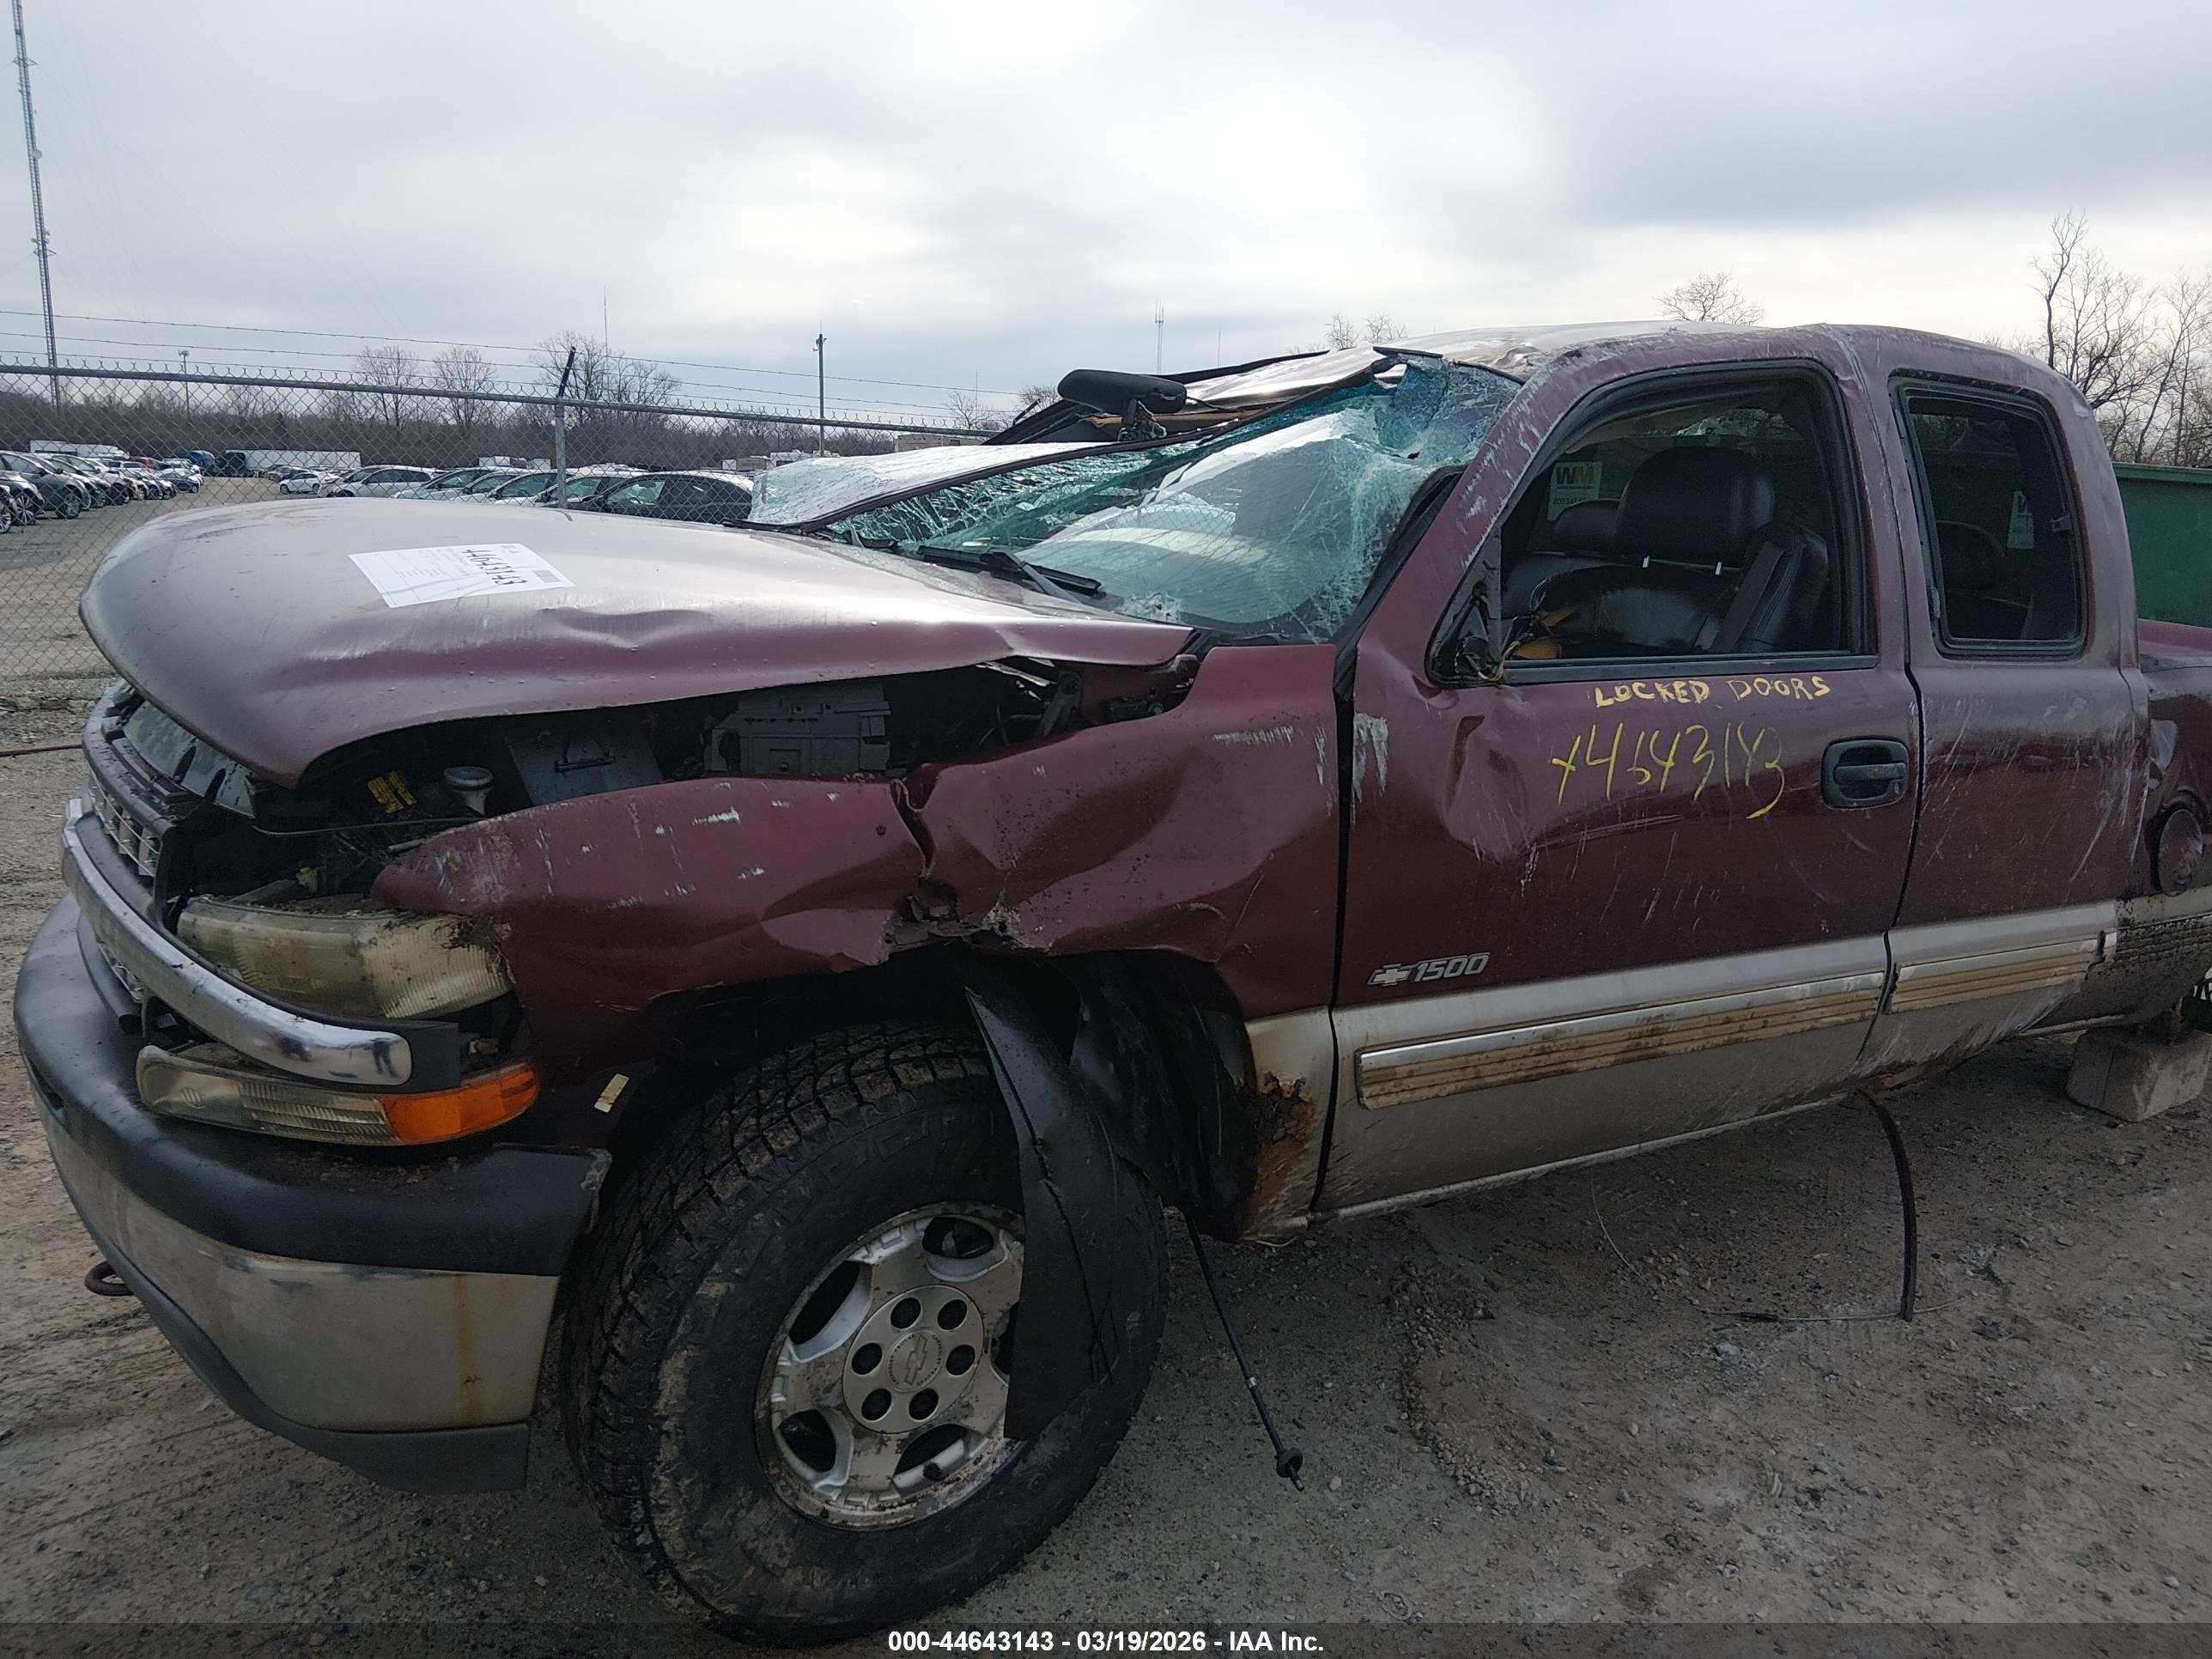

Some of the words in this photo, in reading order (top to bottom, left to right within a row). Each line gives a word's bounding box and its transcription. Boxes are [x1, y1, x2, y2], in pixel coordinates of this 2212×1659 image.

[461, 549, 528, 586] 44643143
[1595, 681, 1711, 708] LOCKED
[1728, 676, 1831, 702] DOORS
[1414, 952, 1491, 982] 1500
